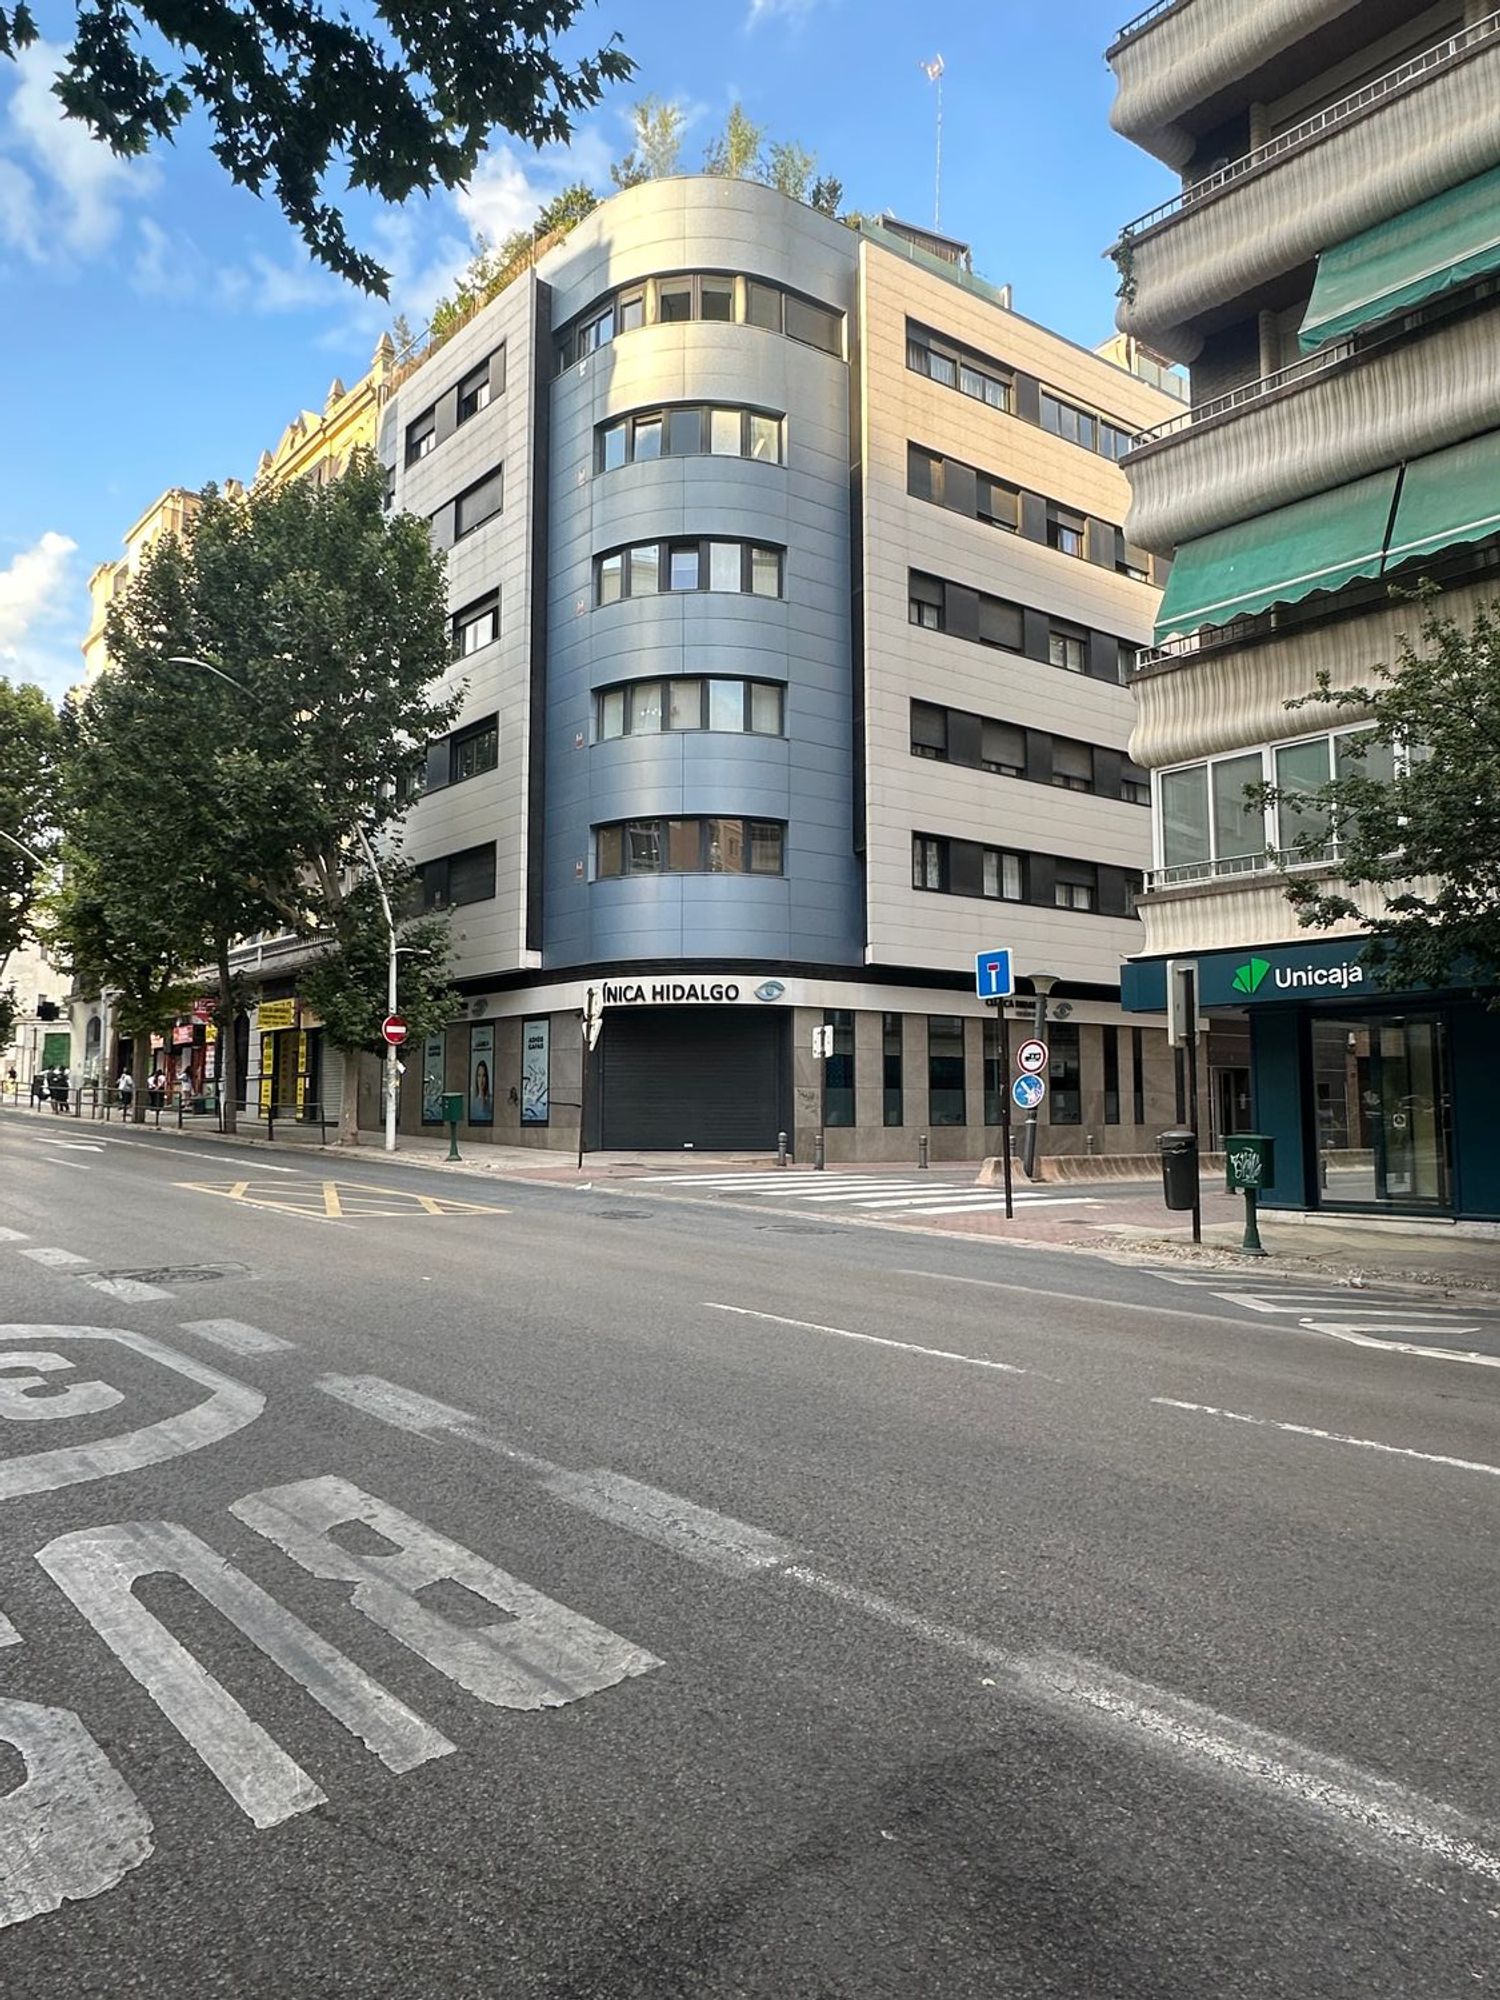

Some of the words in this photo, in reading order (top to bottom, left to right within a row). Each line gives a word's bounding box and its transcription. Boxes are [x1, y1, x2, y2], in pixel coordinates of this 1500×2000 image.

[1275, 962, 1363, 989] Unicaja
[602, 982, 646, 1003] ÍNICA
[652, 984, 740, 1001] HIDALGO
